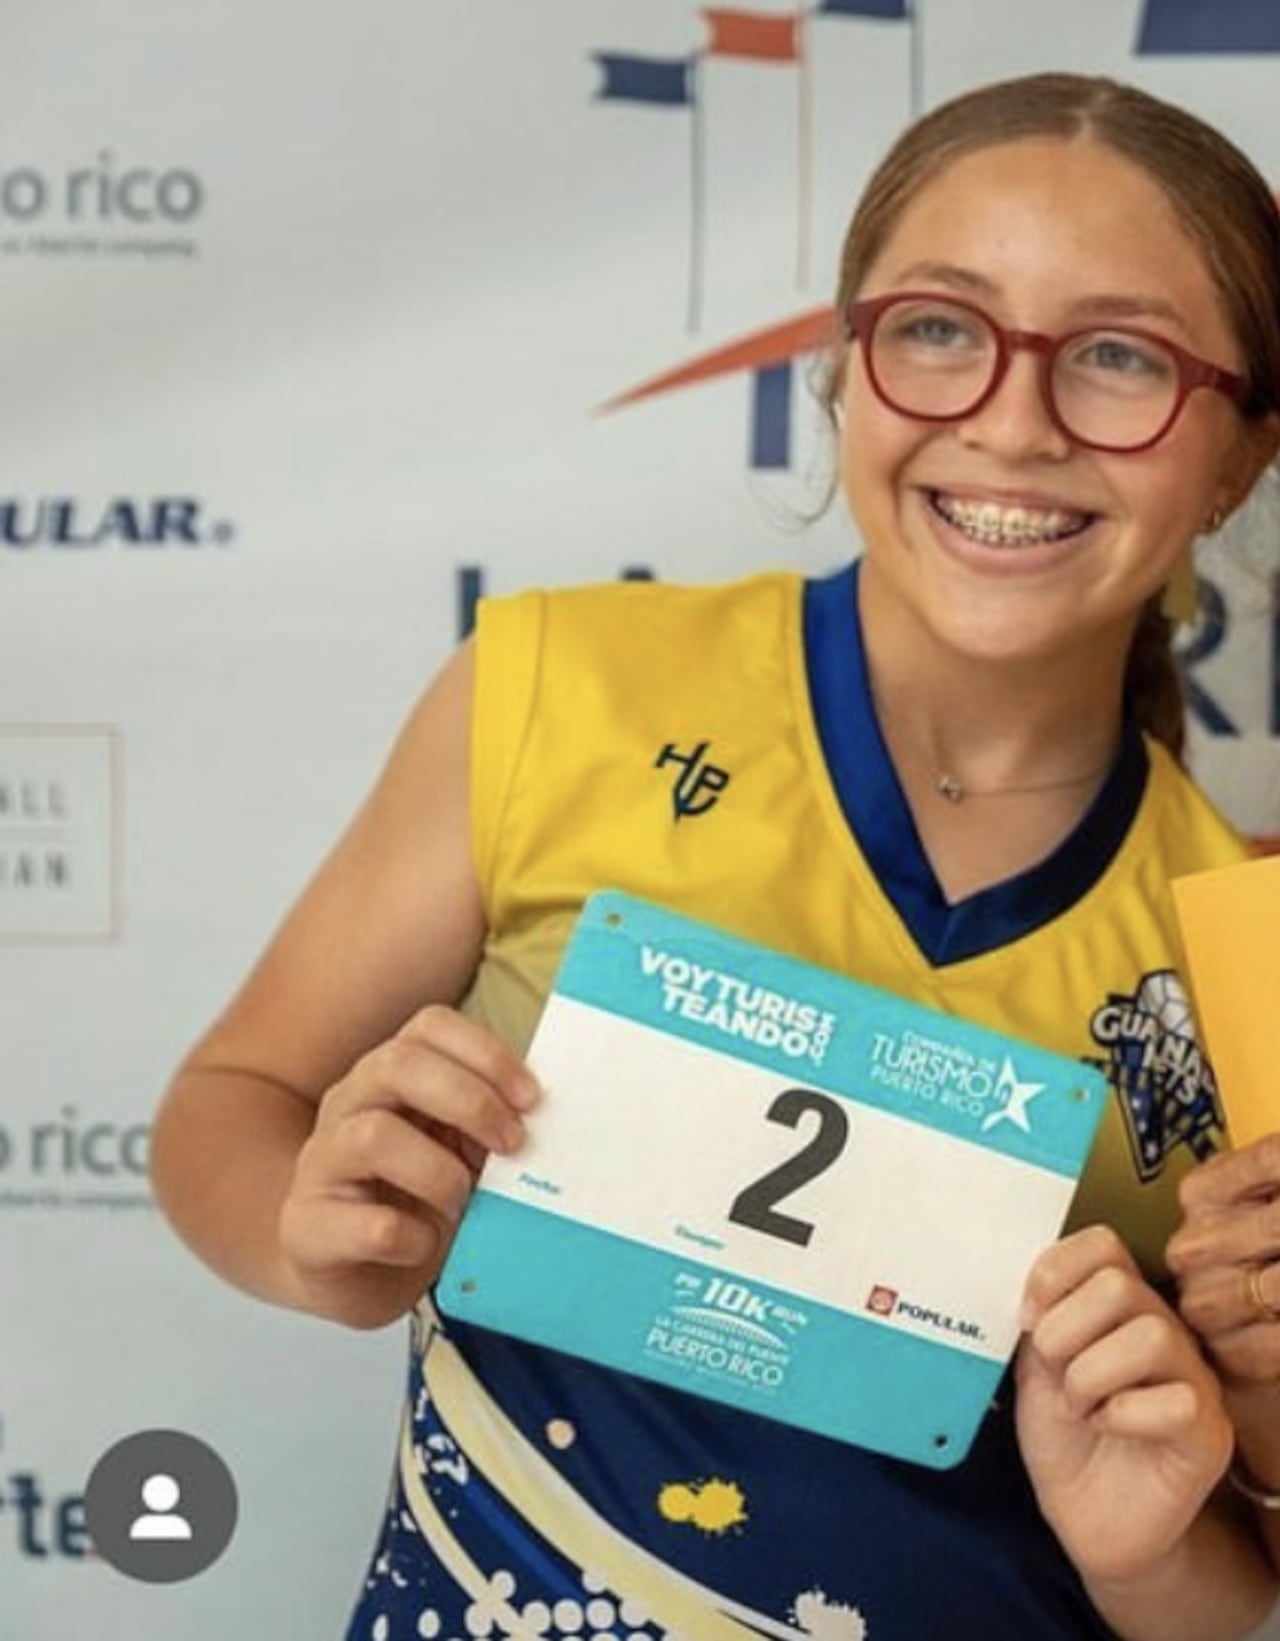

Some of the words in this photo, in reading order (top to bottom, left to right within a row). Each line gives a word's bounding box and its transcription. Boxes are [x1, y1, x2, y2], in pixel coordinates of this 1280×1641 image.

[65, 147, 205, 222] rico
[661, 982, 811, 1058] TEANDO
[871, 1032, 993, 1099] TURISMO
[728, 1087, 849, 1248] 2
[702, 1276, 774, 1322] 10K
[645, 1326, 728, 1369] PUERTO
[728, 1353, 784, 1387] RICO
